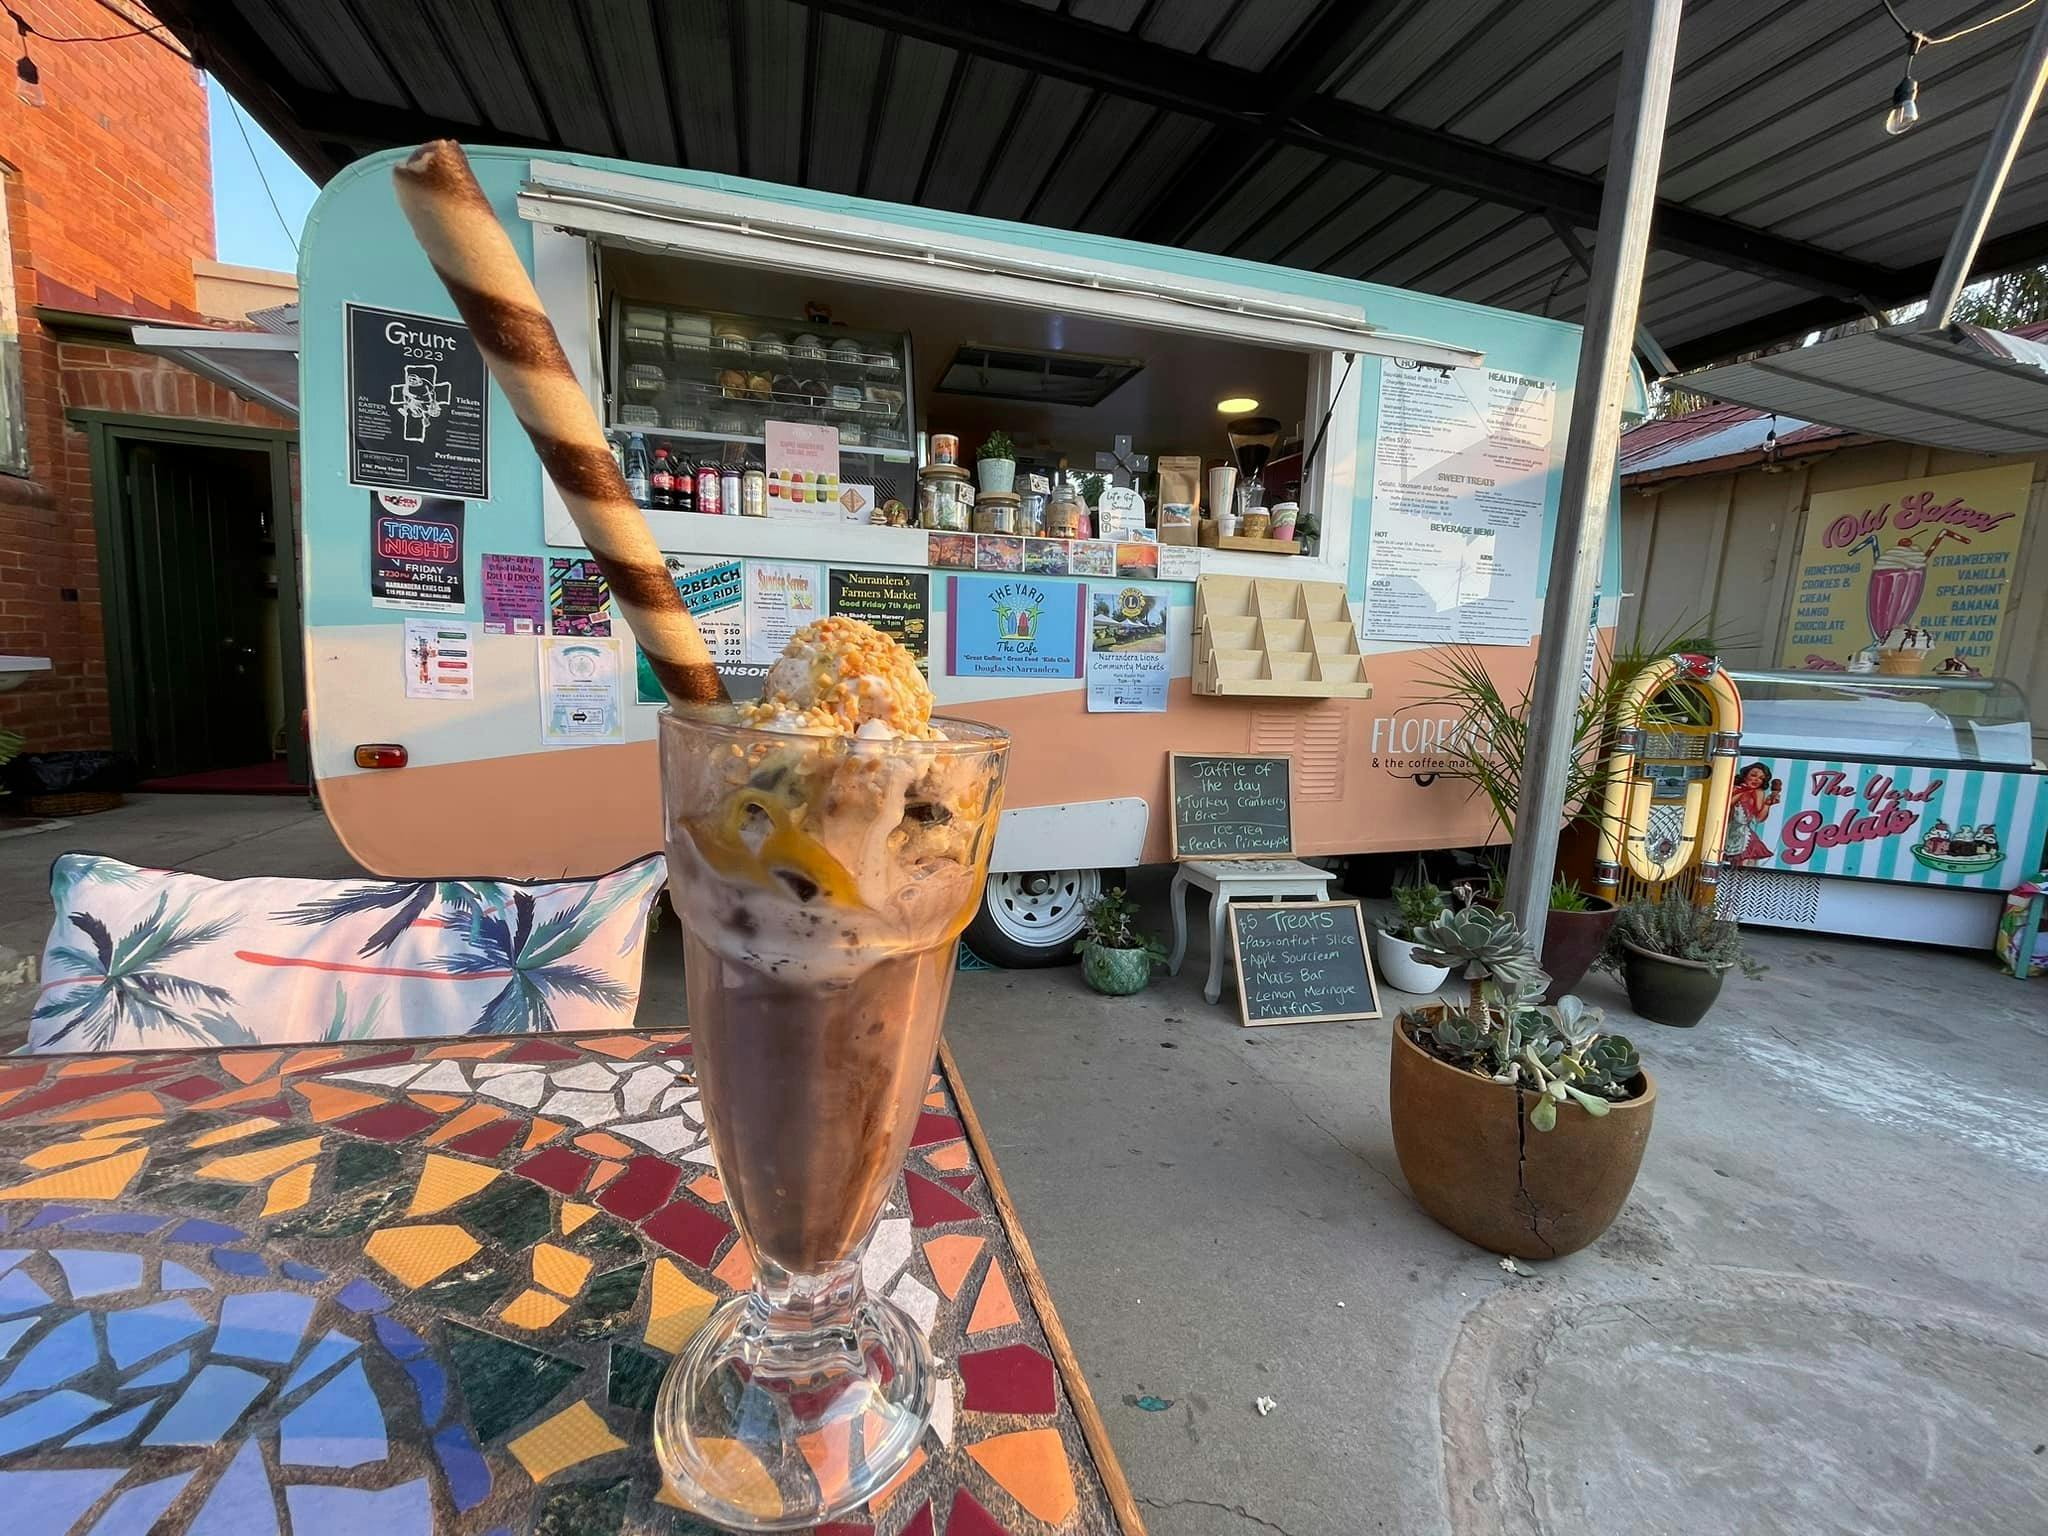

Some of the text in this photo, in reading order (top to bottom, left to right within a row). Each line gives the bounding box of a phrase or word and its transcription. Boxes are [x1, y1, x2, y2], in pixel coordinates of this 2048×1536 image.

[385, 322, 456, 350] Grunt
[403, 347, 444, 361] 2023
[1488, 371, 1545, 389] HEALTH BOWLS
[359, 402, 386, 410] EASTER
[456, 397, 480, 406] Tickets
[359, 408, 390, 416] MUSICAL
[435, 452, 480, 463] Performances
[1438, 473, 1495, 487] SWEET TREATS
[1822, 491, 2016, 548] Old School
[384, 522, 454, 543] TRIVIA
[1430, 523, 1495, 537] BEVERAGE MENU
[385, 538, 454, 559] NIGHT
[1932, 551, 2010, 568] STRAWBERRY
[406, 564, 444, 574] FRIDAY
[700, 565, 714, 573] April
[715, 560, 730, 569] 2023
[1804, 562, 1861, 576] HONEYCOMB
[412, 574, 458, 584] APRIL 21
[849, 573, 910, 586] Narrandera's
[1958, 568, 2006, 580] VANILLA
[677, 568, 741, 596] 2BEACH
[1801, 577, 1851, 590] COOKIES &
[702, 585, 740, 603] & RIDE
[842, 587, 917, 600] Farmers Market
[988, 583, 1045, 604] THE YARD
[1936, 583, 2005, 597] SPEARMINT
[1799, 593, 1831, 604] CREAM
[1951, 599, 2000, 611] BANANA
[862, 601, 887, 609] Friday
[903, 602, 920, 610] April
[1797, 607, 1829, 617] MANGO
[1793, 620, 1845, 631] CHOCOLATE
[1920, 614, 1998, 627] BLUE HEAVEN
[1792, 634, 1833, 645] CARAMEL
[1944, 630, 1966, 642] NOT
[1969, 630, 1994, 642] ADD
[997, 641, 1038, 655] The Cafe
[1098, 650, 1160, 661] Narrandera Lions
[974, 664, 1005, 673] Douglas
[1016, 664, 1060, 673] Narrandera
[1093, 662, 1165, 672] Community Markets
[1190, 761, 1274, 778] Jaffle of
[1371, 758, 1379, 768] &
[1385, 758, 1404, 768] the
[1408, 758, 1445, 768] coffee
[1234, 779, 1261, 799] day
[1812, 770, 1943, 812] The Yard
[1184, 795, 1287, 816] Turkey Cranberry
[1194, 811, 1217, 821] Brie
[1240, 826, 1263, 836] Tea
[1781, 801, 1919, 865] Gelato
[1189, 836, 1227, 851] Peach
[1239, 911, 1334, 934] $5 Treats
[1327, 935, 1355, 945] Slice
[1250, 950, 1340, 969] Apple Sourcream
[1256, 968, 1325, 985] Mars Bar
[1256, 985, 1357, 1006] Lemon Meringue
[1261, 1001, 1323, 1016] Muffins
